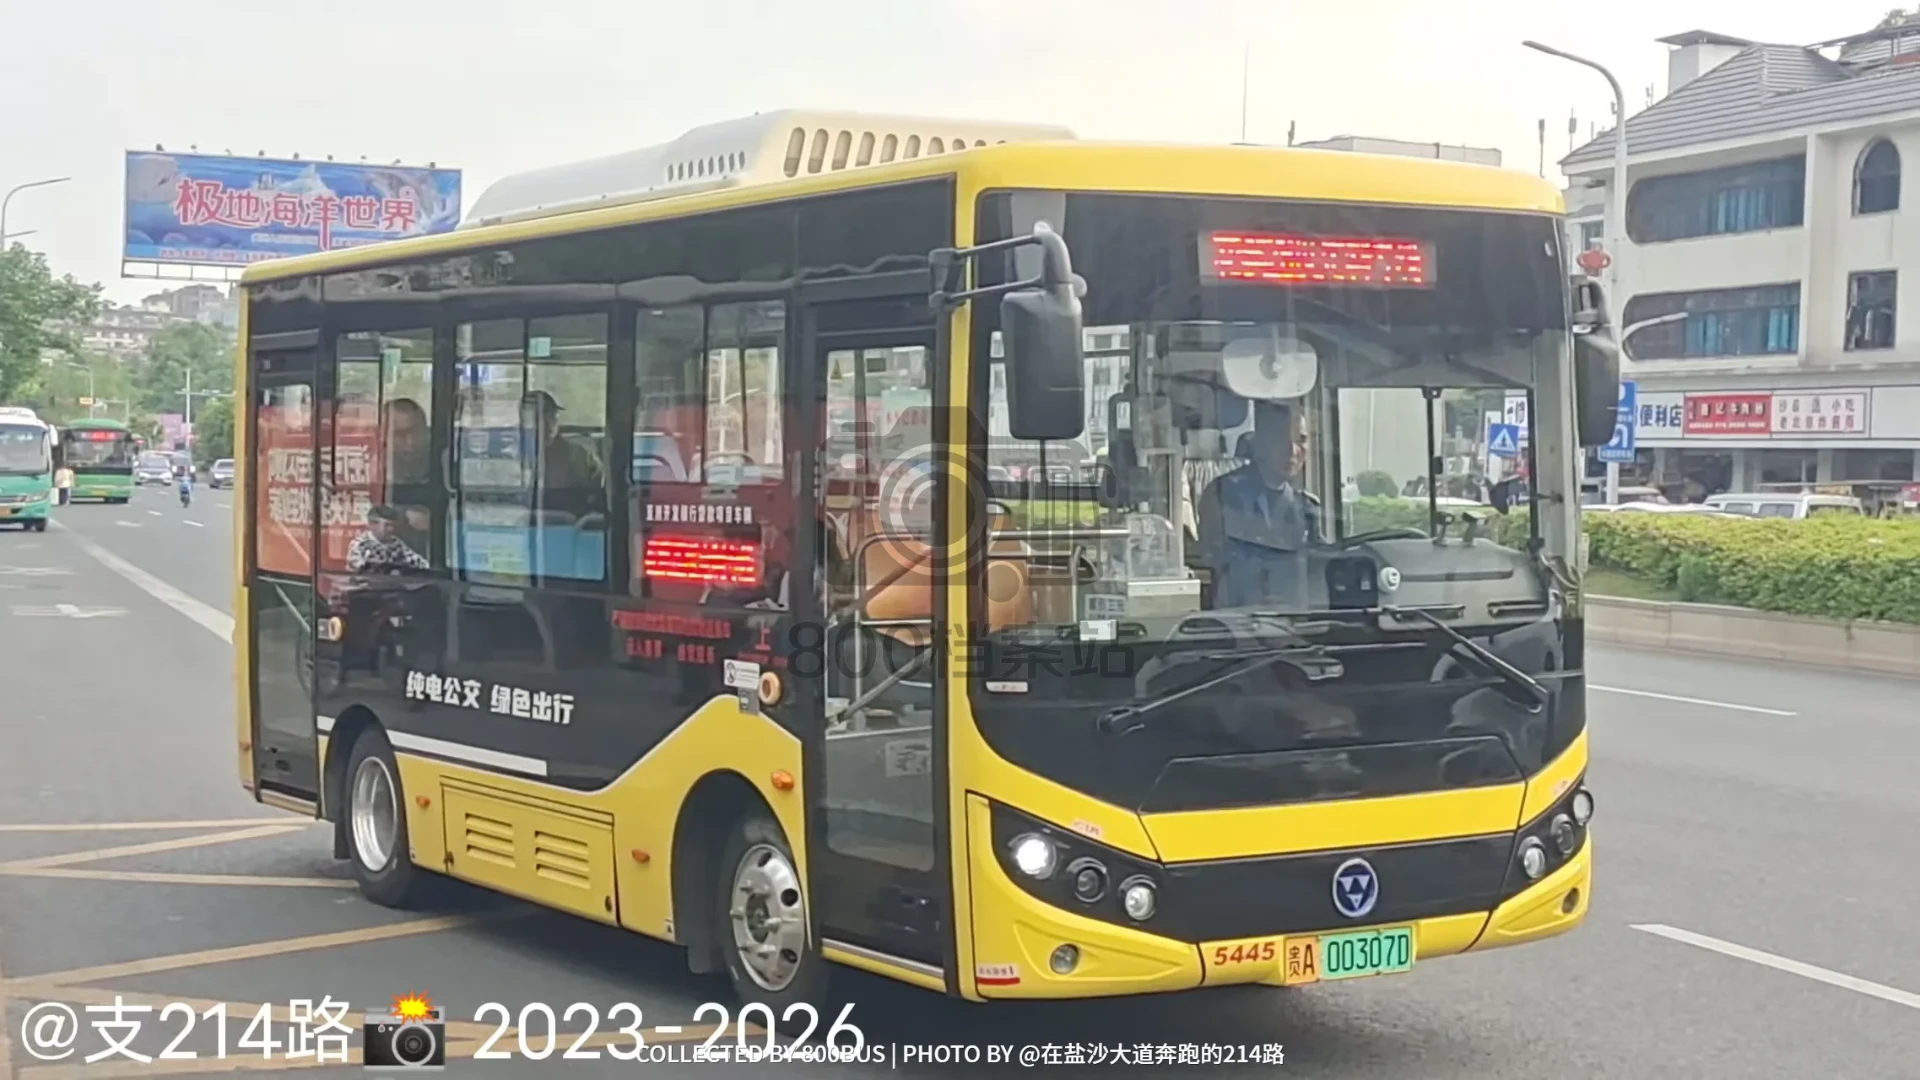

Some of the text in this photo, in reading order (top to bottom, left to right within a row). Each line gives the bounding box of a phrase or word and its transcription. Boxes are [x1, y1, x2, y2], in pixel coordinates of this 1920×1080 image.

[176, 178, 416, 250] 极地海洋世界
[1635, 404, 1682, 428] 便利店
[406, 670, 574, 724] 纯电公交 绿色出行
[1213, 941, 1276, 966] 5445
[1327, 933, 1410, 973] 00307D
